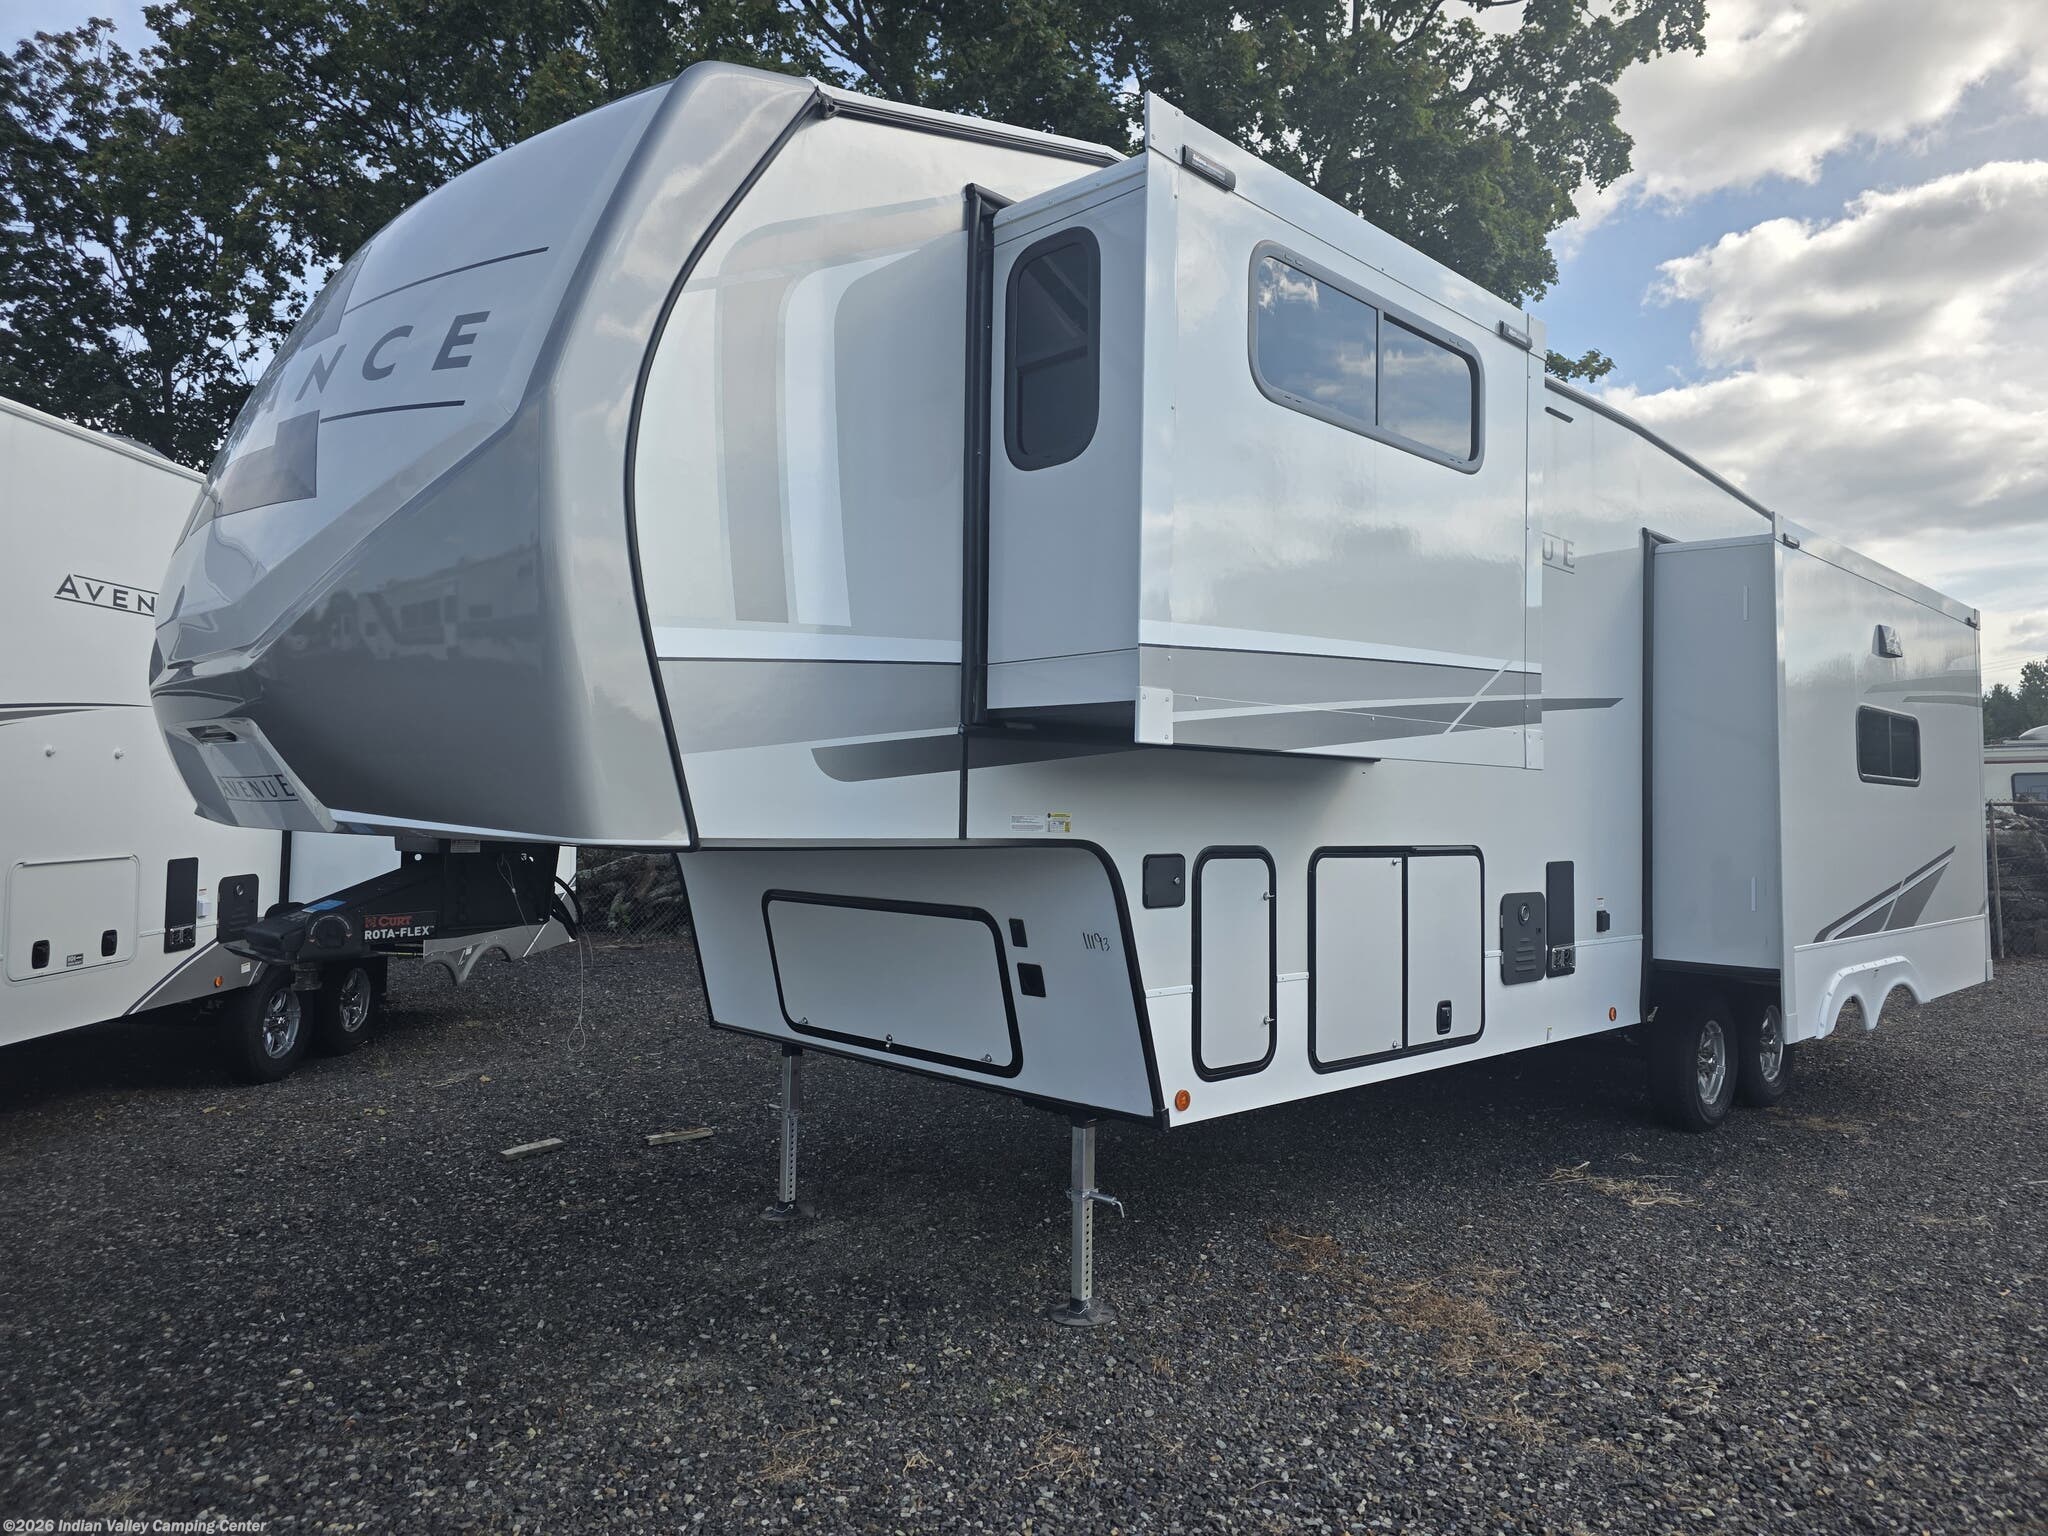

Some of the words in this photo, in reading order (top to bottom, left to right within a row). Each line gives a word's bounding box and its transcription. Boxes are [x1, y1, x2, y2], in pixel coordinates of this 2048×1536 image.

[56, 574, 155, 613] AVEN
[220, 774, 295, 798] AVENUE
[379, 915, 412, 927] CURT
